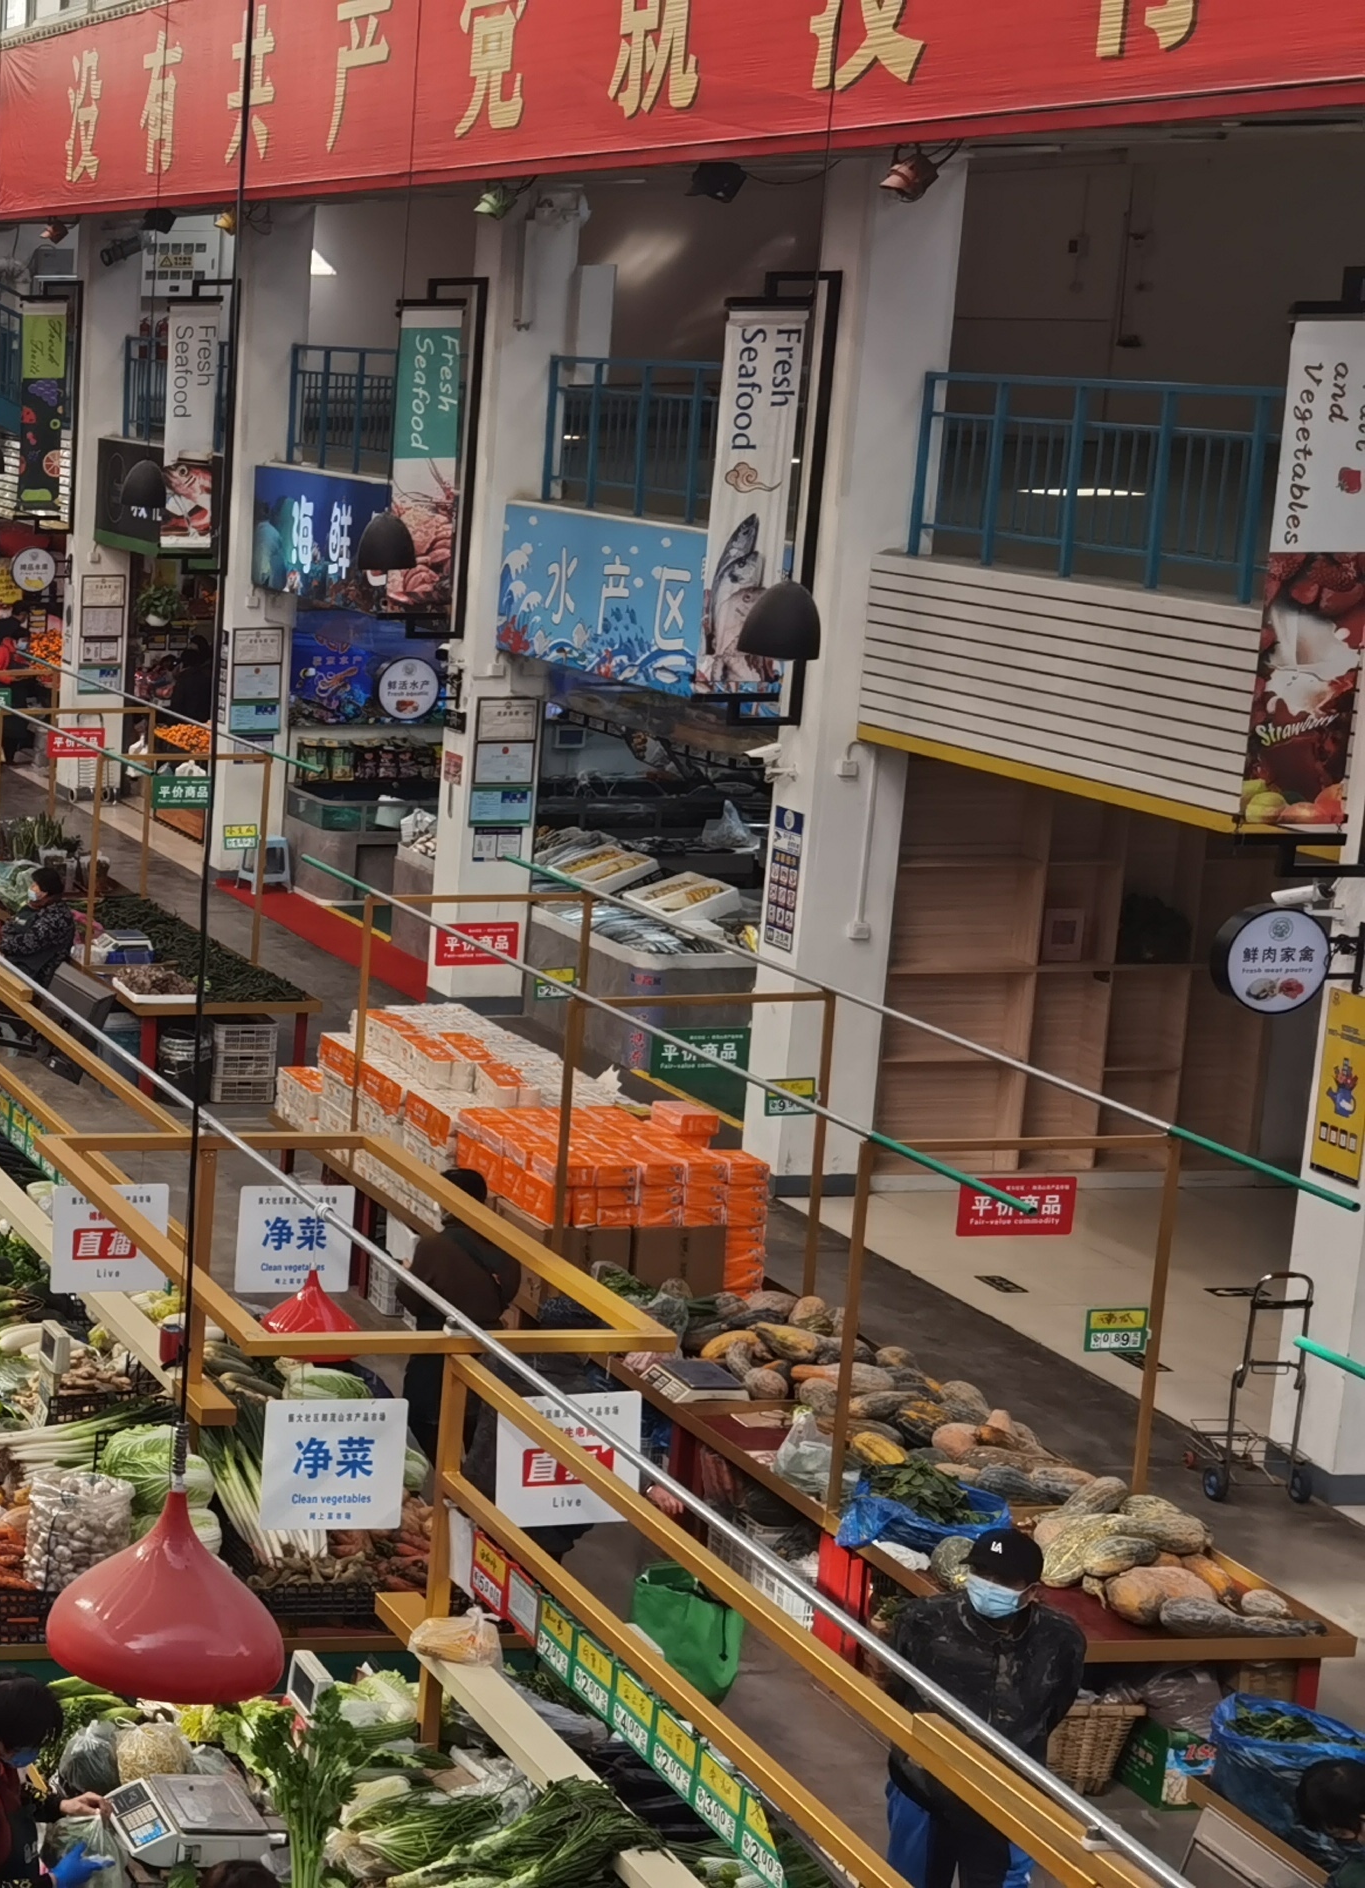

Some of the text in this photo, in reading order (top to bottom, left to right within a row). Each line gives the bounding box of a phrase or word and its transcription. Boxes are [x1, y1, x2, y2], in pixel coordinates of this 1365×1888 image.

[172, 325, 195, 419] Seafood
[196, 324, 217, 387] Fresh
[438, 335, 459, 412] Fresh
[770, 328, 802, 408] Fresh
[410, 336, 435, 451] Seafood
[731, 328, 767, 450] Seafood
[1327, 361, 1350, 424] and
[1283, 362, 1324, 546] Vegetables
[545, 546, 692, 651] 水产区
[387, 680, 430, 690] 鲜活水产
[157, 785, 209, 799] 平价商品
[1242, 946, 1316, 963] 鲜肉家禽
[261, 1217, 327, 1254] 净菜
[969, 1217, 1060, 1226] Fair-value commodity
[95, 1267, 121, 1278] Live
[261, 1261, 285, 1273] Clean
[292, 1436, 375, 1479] 净菜
[291, 1492, 372, 1506] Clean vegetables
[551, 1496, 582, 1508] Live
